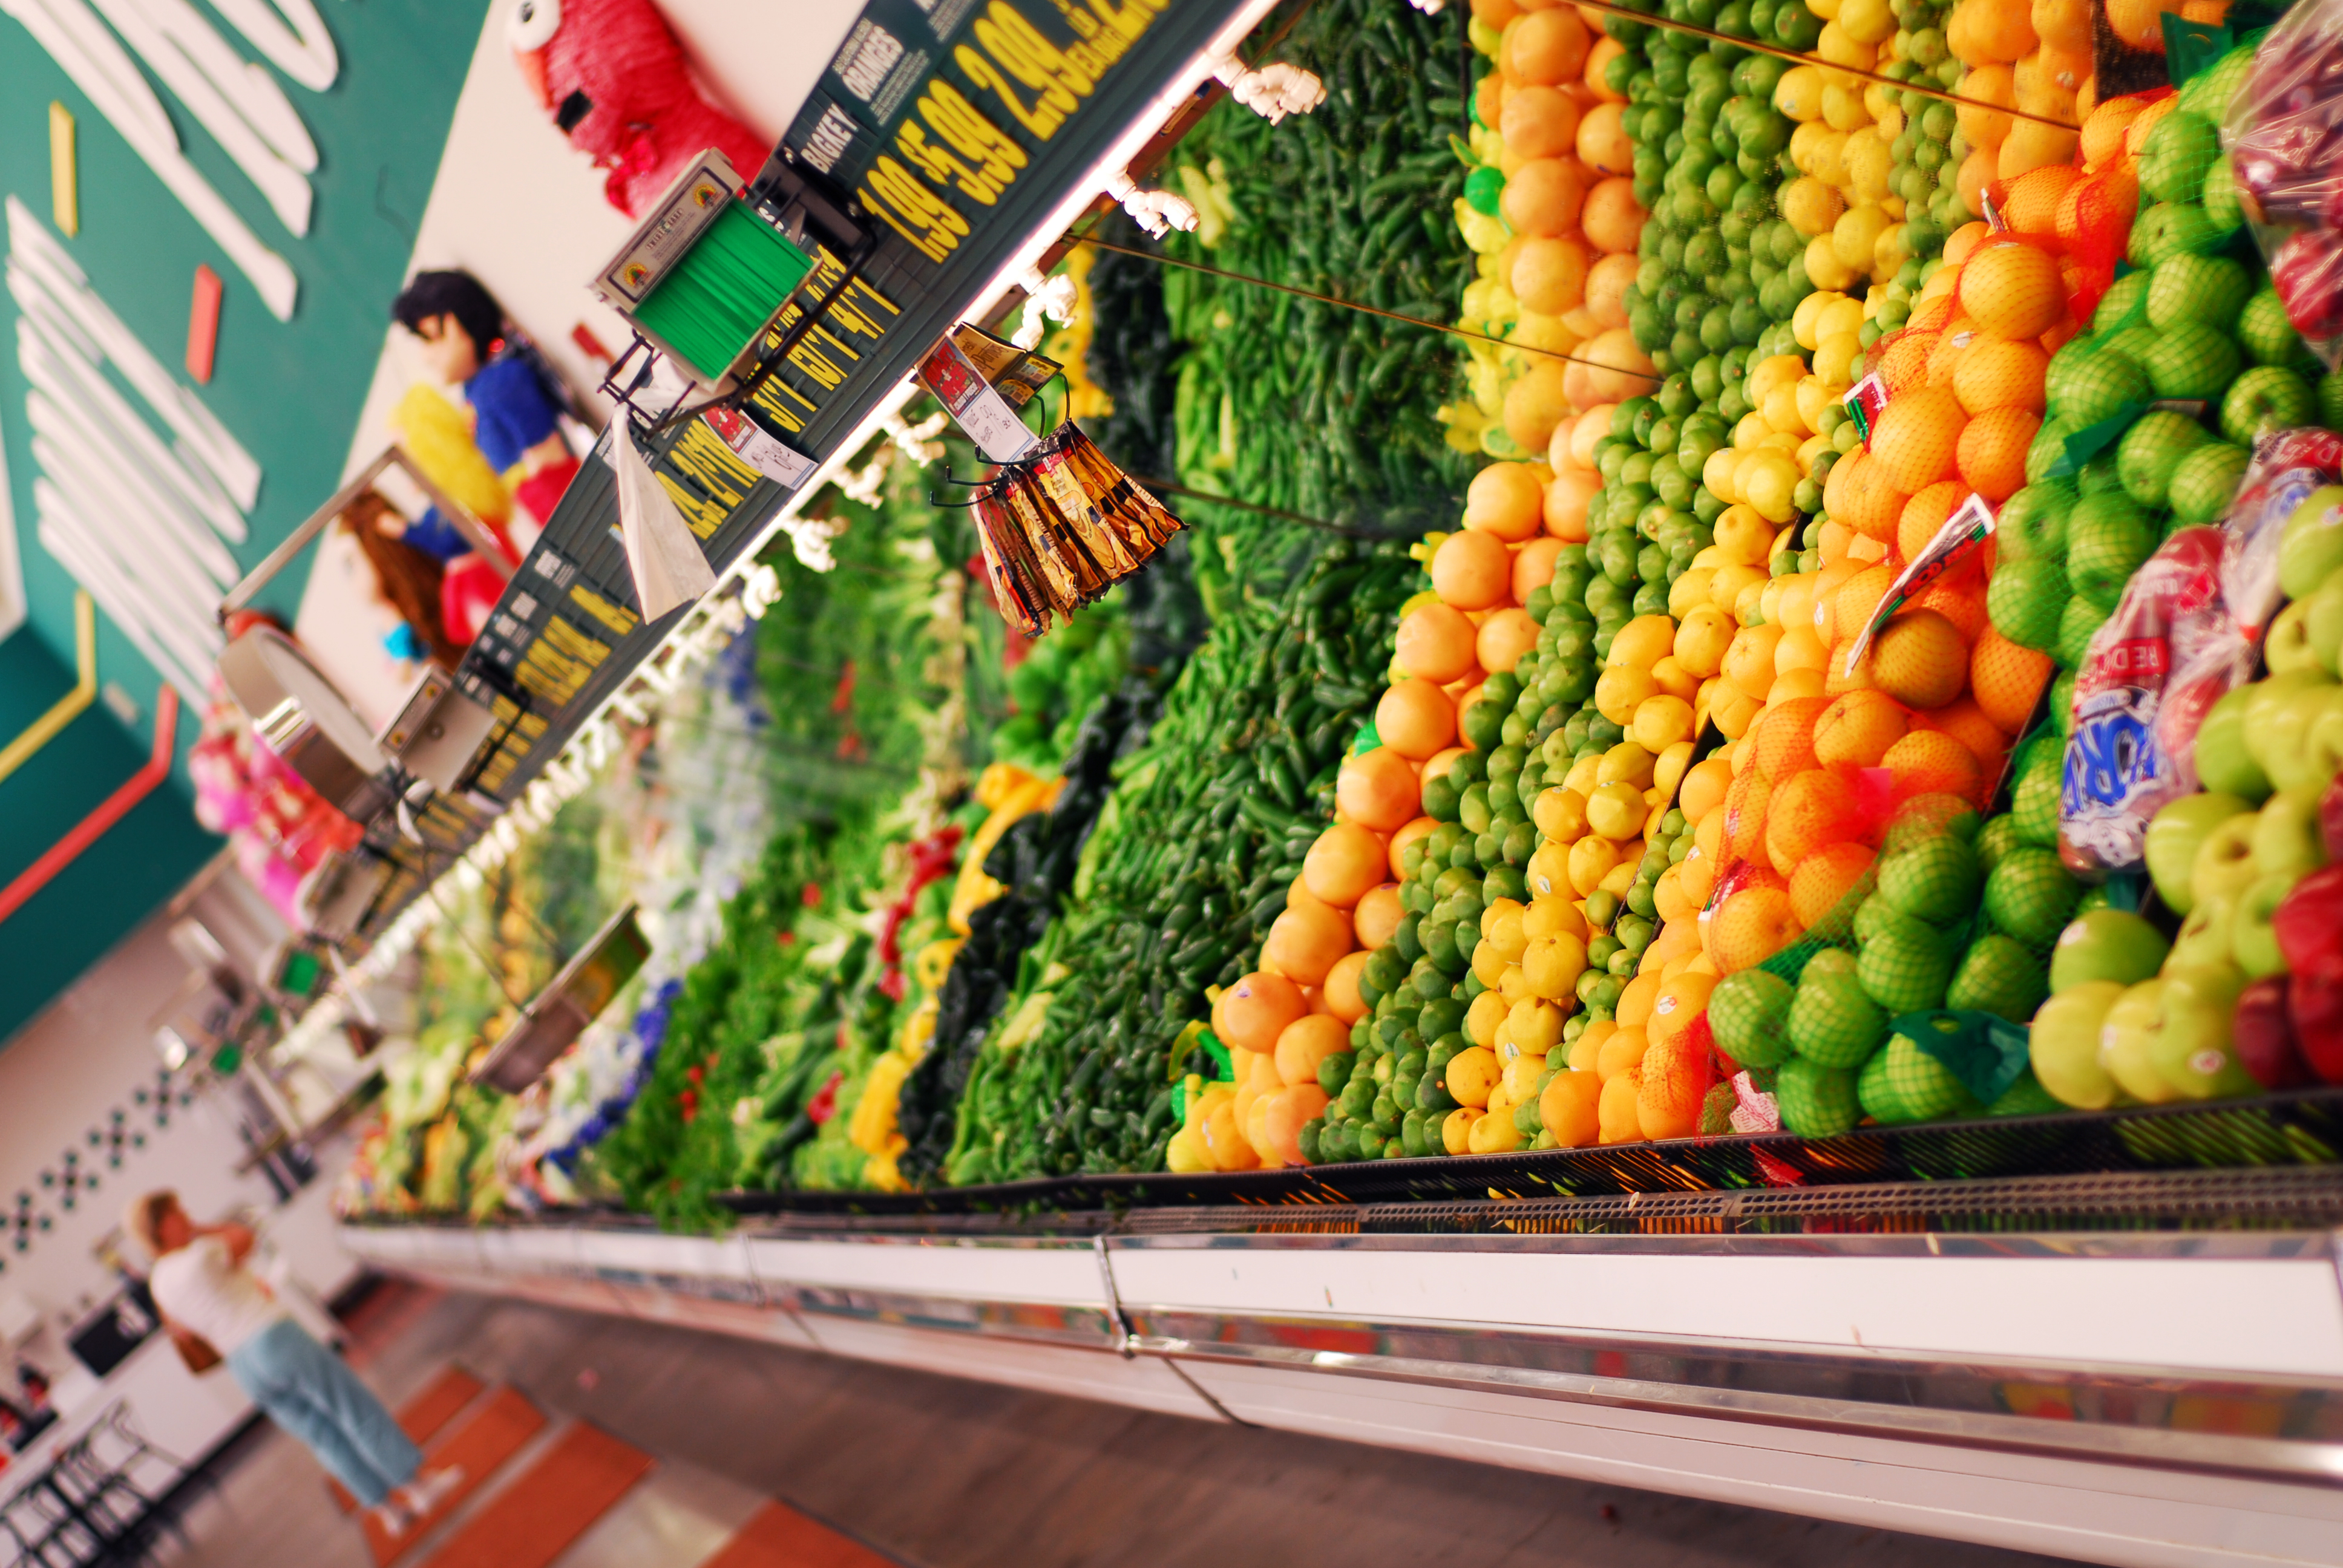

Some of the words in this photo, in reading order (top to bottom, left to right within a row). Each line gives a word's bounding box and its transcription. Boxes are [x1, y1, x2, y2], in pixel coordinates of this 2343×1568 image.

[842, 25, 905, 102] ORANGES
[954, 0, 1095, 142] 2.99
[801, 103, 859, 174] BAGKEY
[896, 79, 1028, 206] $5.99
[857, 154, 971, 264] 1.99
[805, 244, 900, 339] 4/$1
[655, 471, 722, 540] .29
